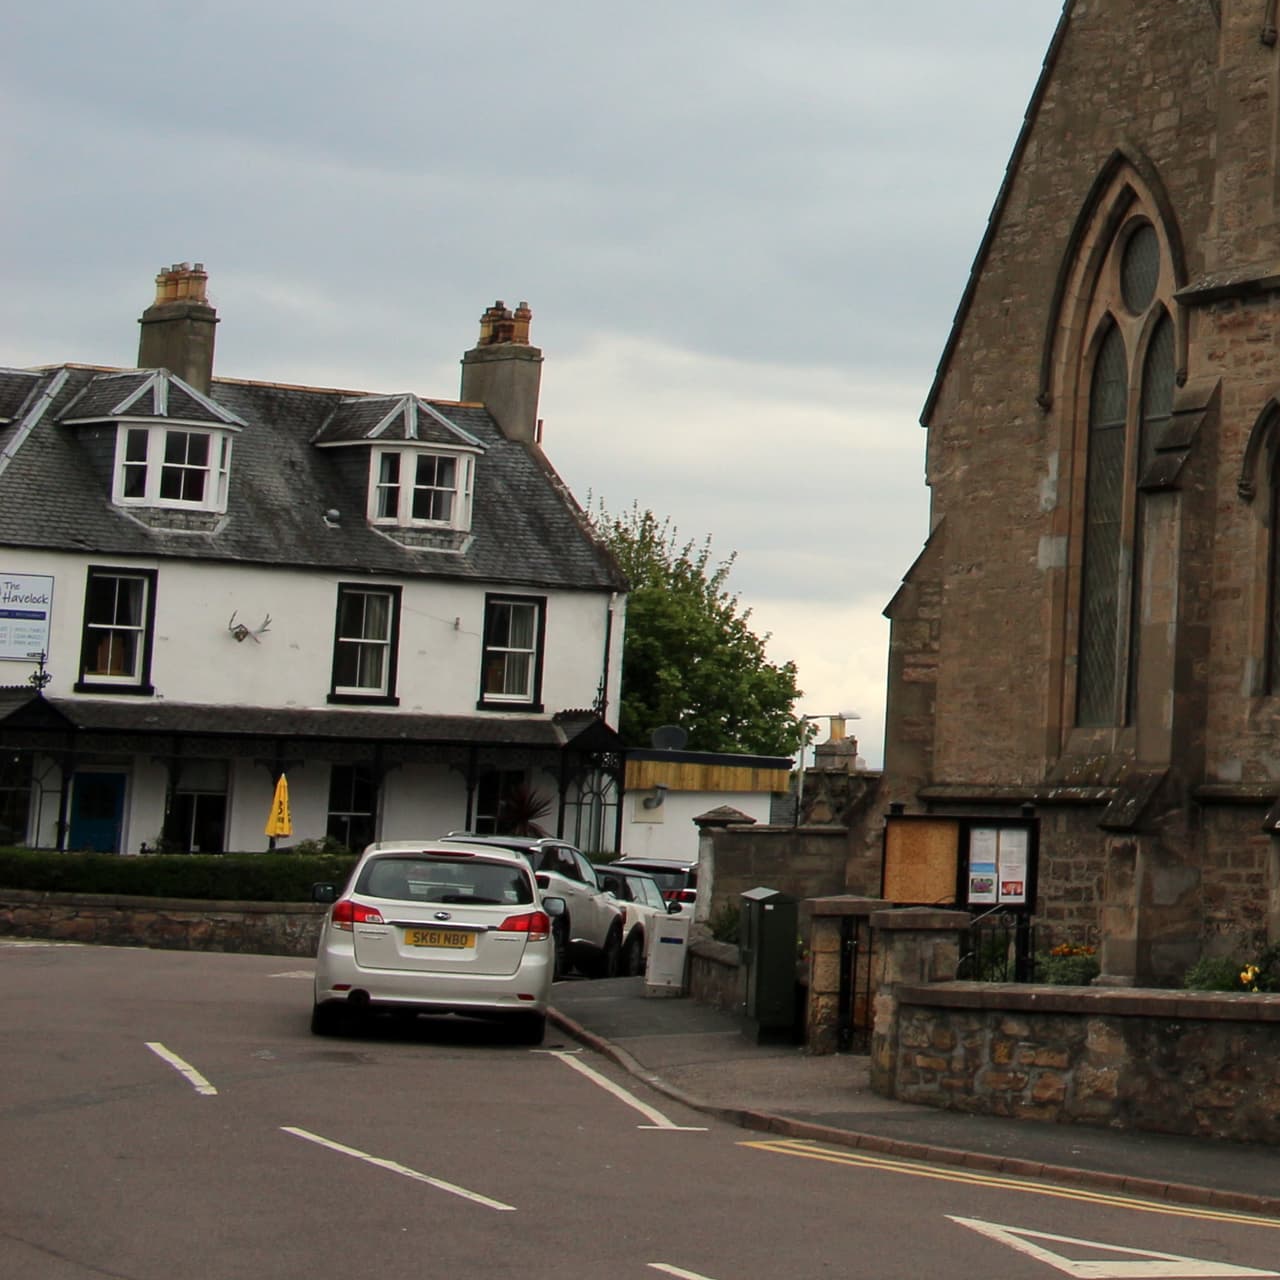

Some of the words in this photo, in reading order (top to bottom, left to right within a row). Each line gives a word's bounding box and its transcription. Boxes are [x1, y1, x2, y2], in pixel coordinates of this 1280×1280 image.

[4, 581, 20, 590] The
[3, 591, 48, 604] Havelock
[414, 931, 441, 945] SK61
